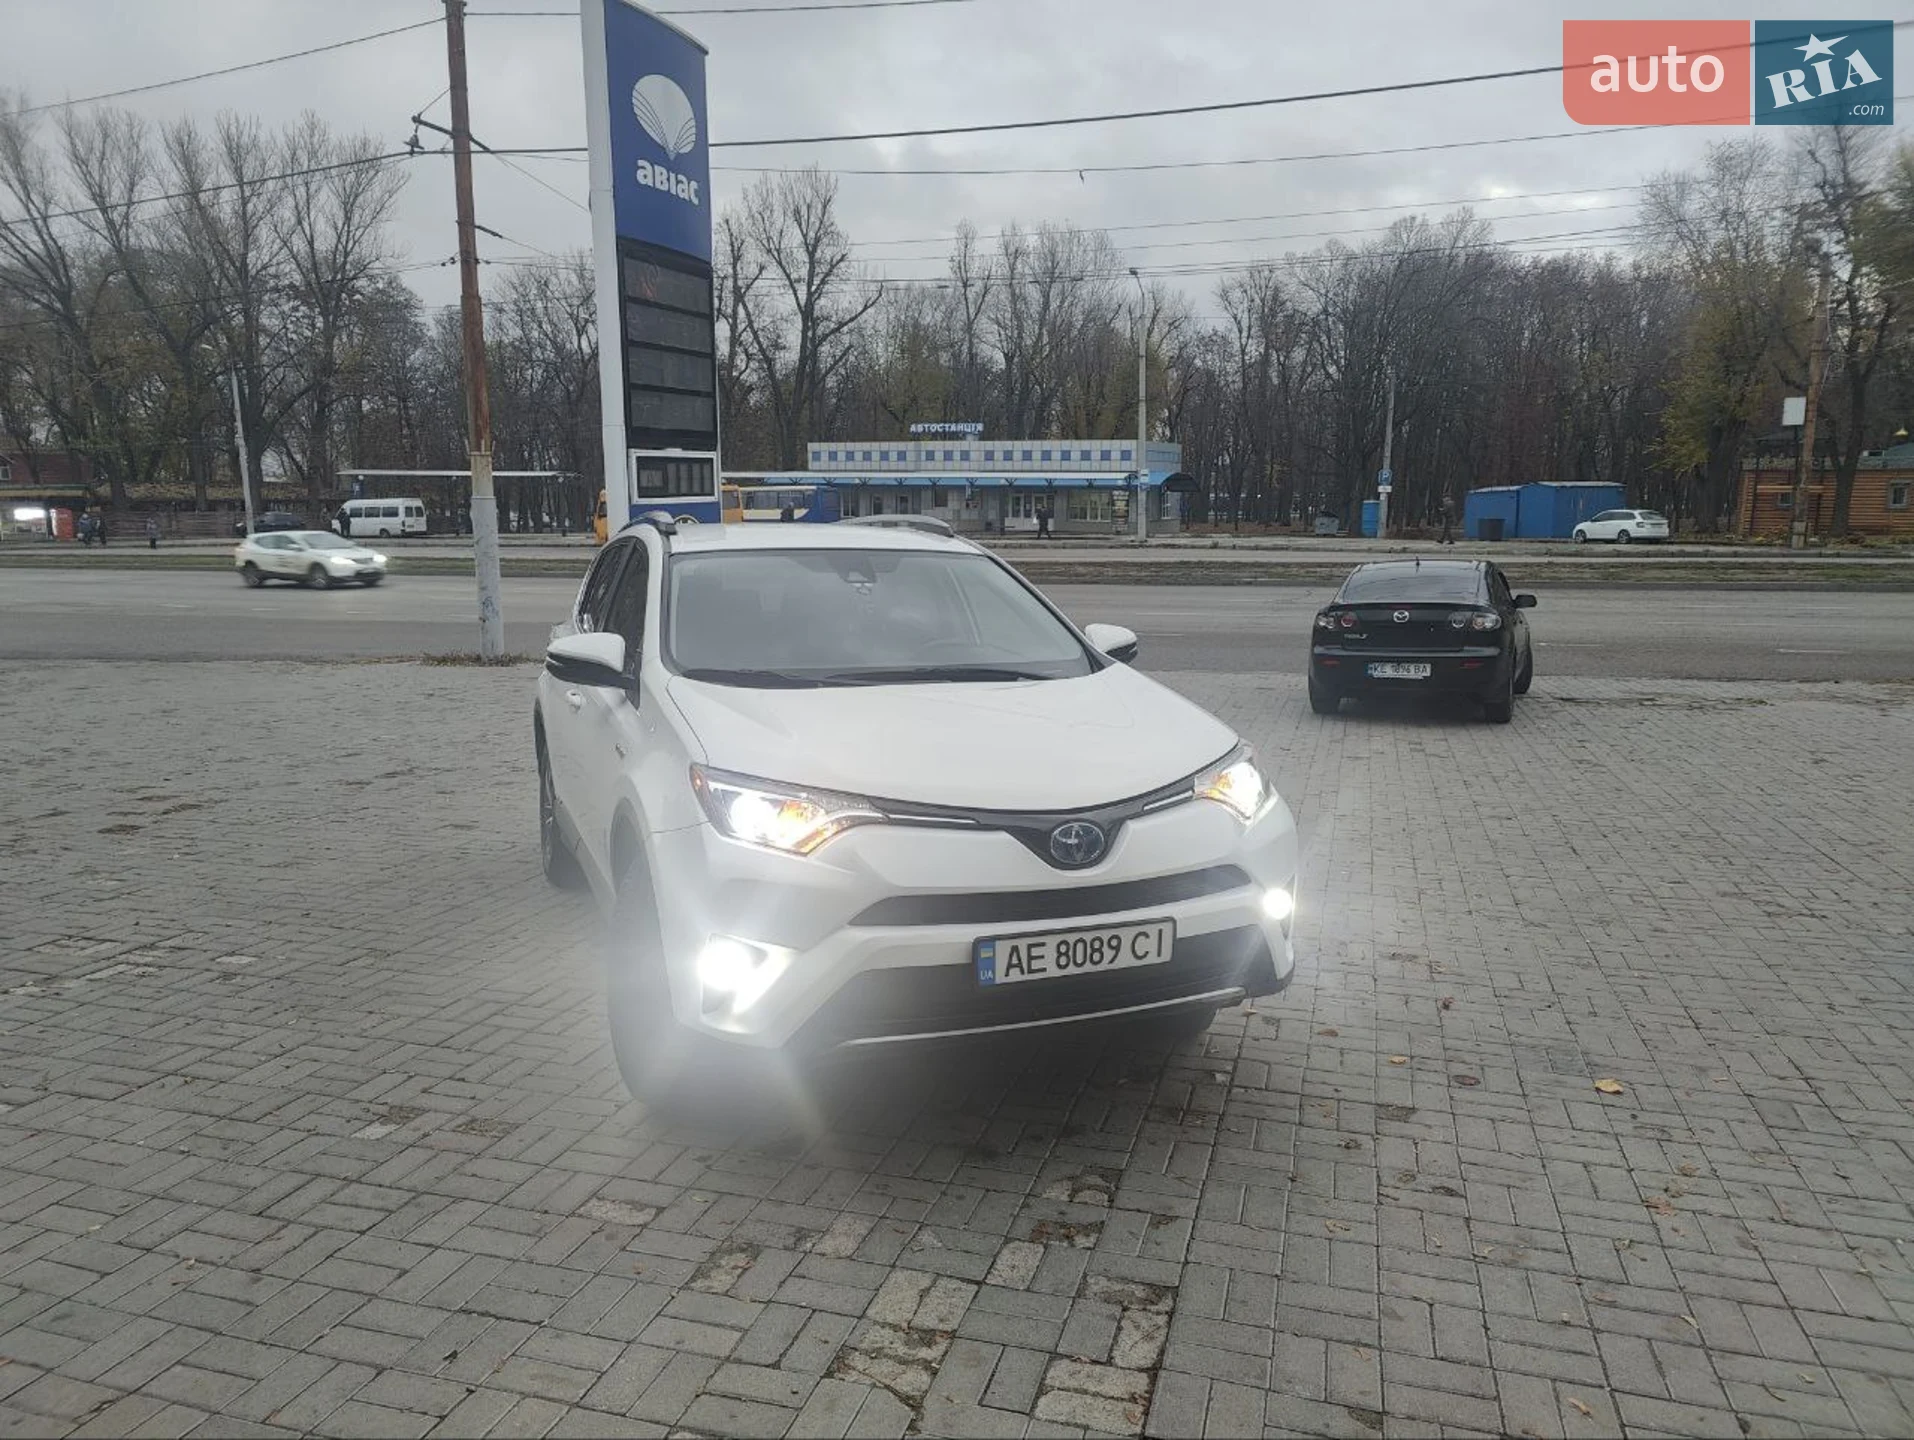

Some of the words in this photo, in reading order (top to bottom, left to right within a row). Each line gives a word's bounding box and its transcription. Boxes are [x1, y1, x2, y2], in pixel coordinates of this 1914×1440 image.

[910, 422, 983, 433] АВТОСТАНЦІЯ
[1414, 664, 1428, 674] BA
[1004, 941, 1047, 978] AE
[1055, 934, 1122, 970] 8089
[1130, 928, 1164, 961] CI
[980, 969, 994, 981] UA
